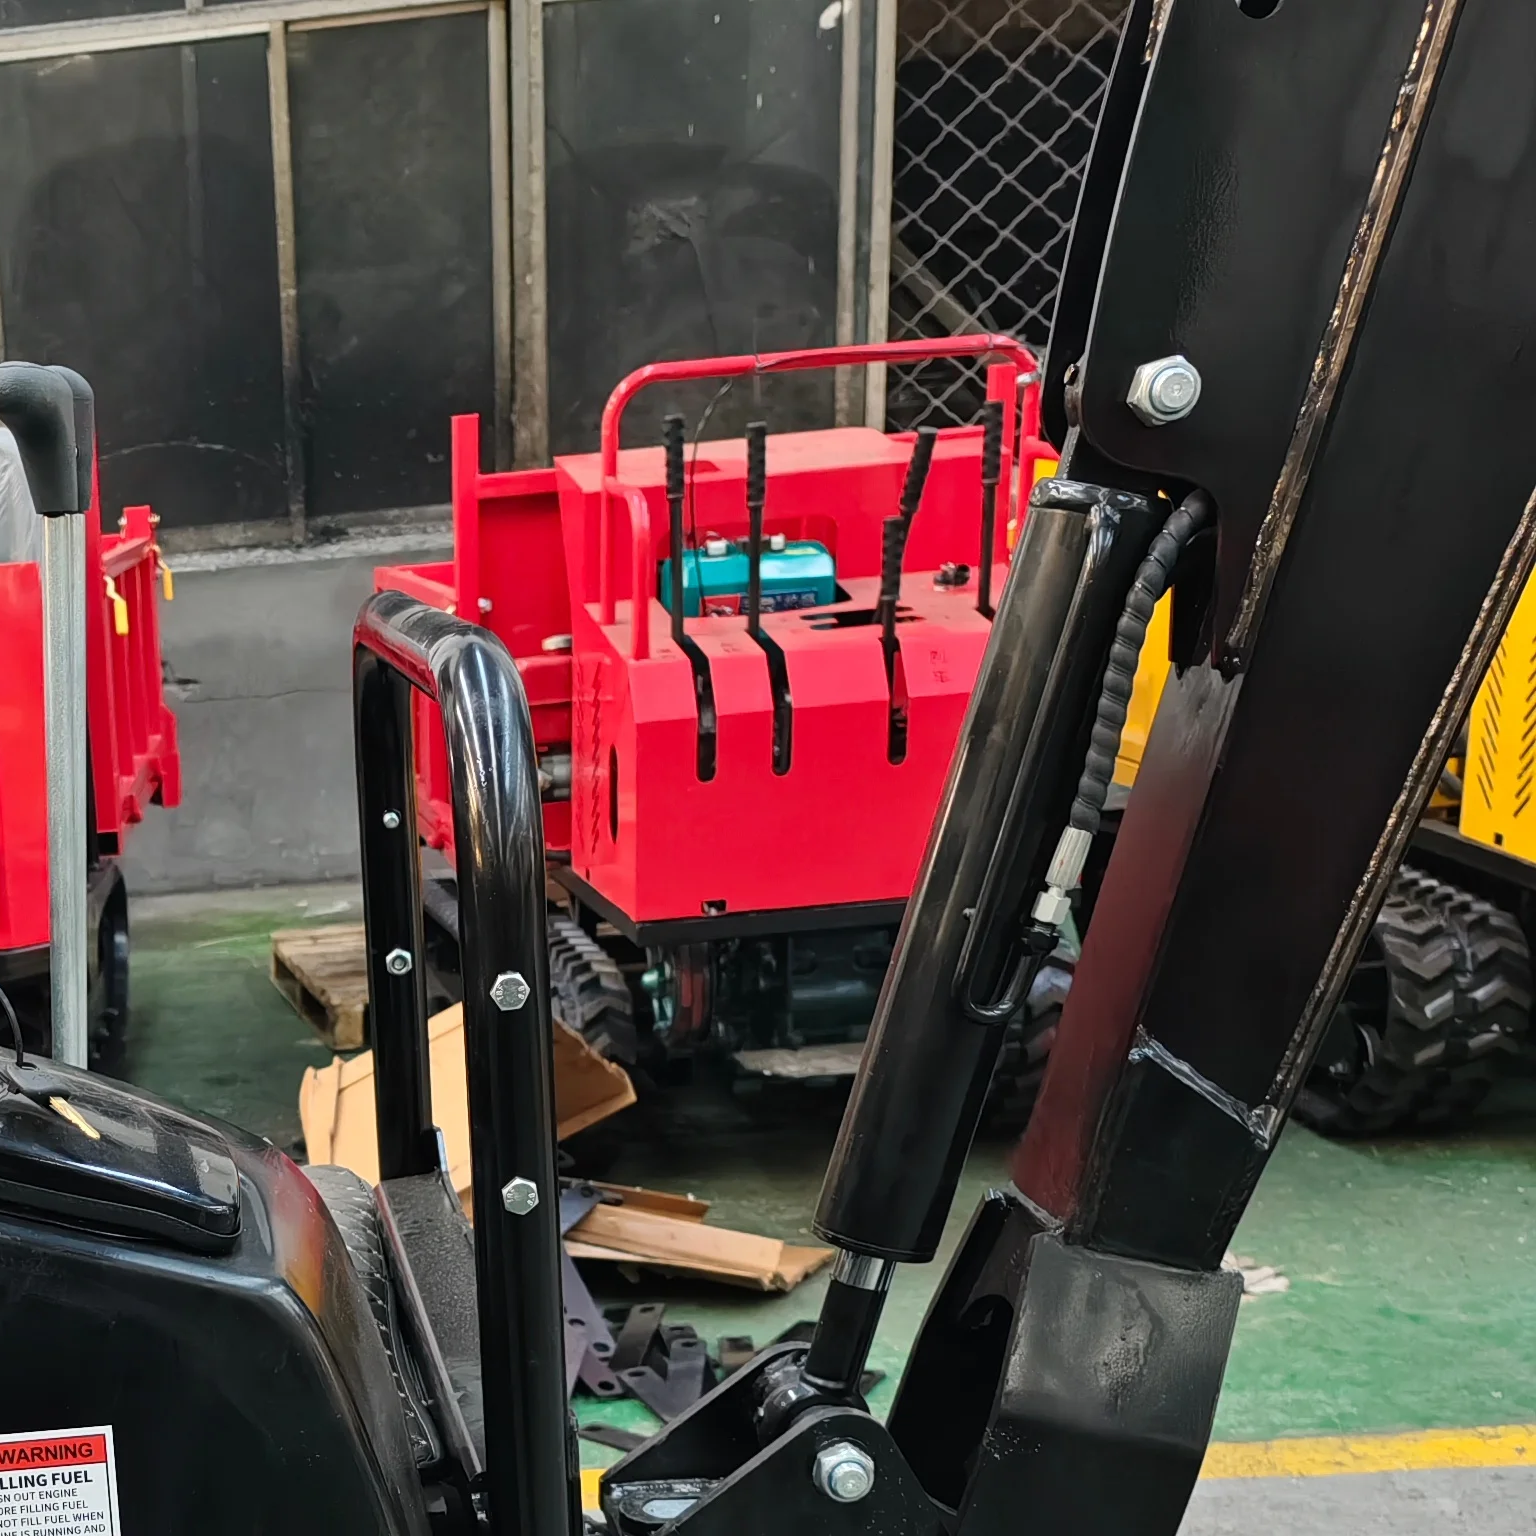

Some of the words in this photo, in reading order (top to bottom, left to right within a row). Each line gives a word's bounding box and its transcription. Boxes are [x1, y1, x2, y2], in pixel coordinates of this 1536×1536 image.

[52, 1470, 93, 1485] FUEL
[14, 1492, 35, 1501] OUT
[39, 1488, 78, 1499] ENGINE
[20, 1503, 59, 1514] FILLING
[63, 1500, 88, 1510] FUEL
[21, 1517, 42, 1526] FILL
[45, 1514, 70, 1524] FUEL
[73, 1512, 104, 1522] WHEN
[84, 1524, 105, 1533] AND
